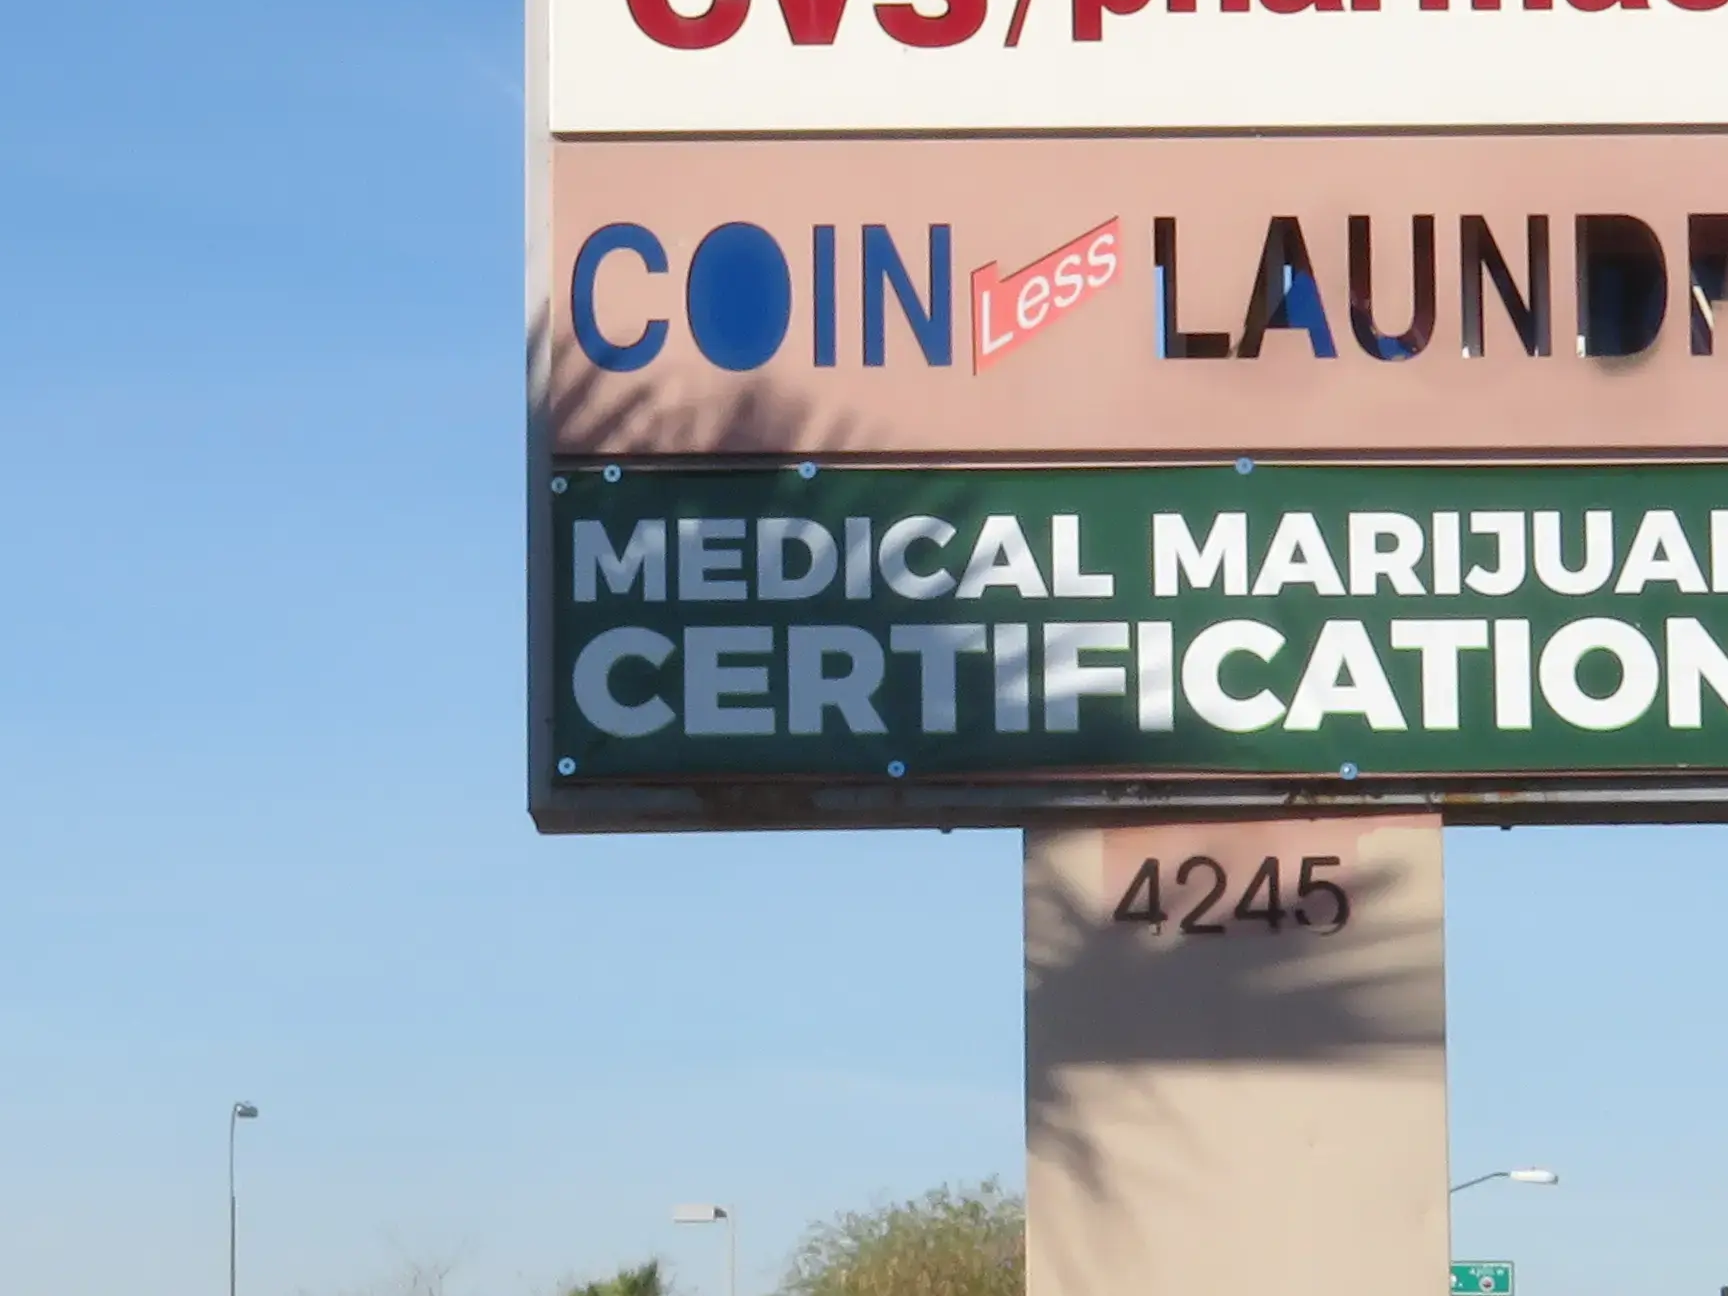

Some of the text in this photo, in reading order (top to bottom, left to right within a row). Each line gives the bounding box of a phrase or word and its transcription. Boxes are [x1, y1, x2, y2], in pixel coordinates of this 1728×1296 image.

[571, 222, 952, 371] COIN
[983, 234, 1118, 353] Less
[574, 513, 1115, 602] MEDICAL
[1113, 855, 1352, 935] 4245
